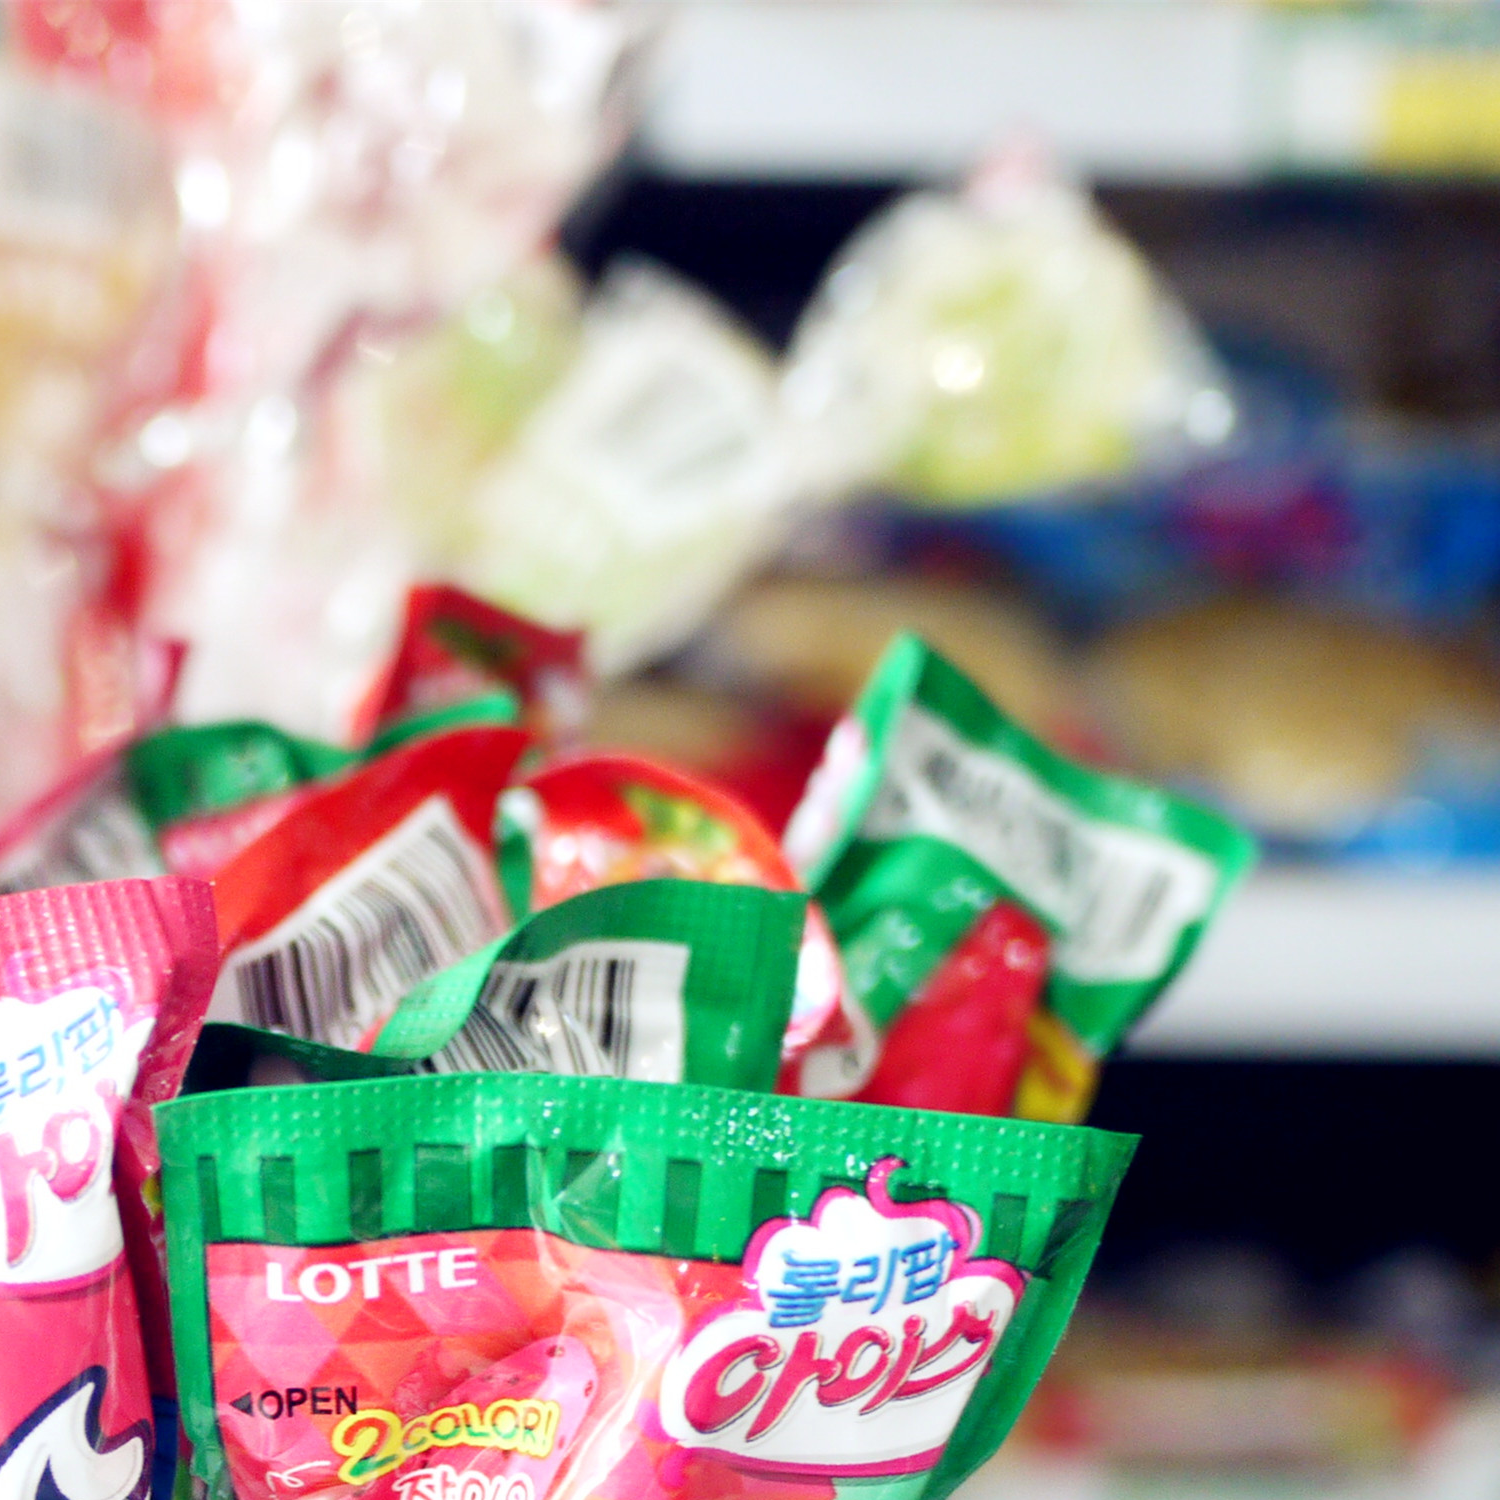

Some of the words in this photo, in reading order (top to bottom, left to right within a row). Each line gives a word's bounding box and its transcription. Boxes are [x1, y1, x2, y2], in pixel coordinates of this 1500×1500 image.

[265, 1247, 478, 1305] LOTTE
[767, 1230, 961, 1329] 롤리팝
[257, 1385, 359, 1420] OPEN
[683, 1300, 1000, 1442] 아이스
